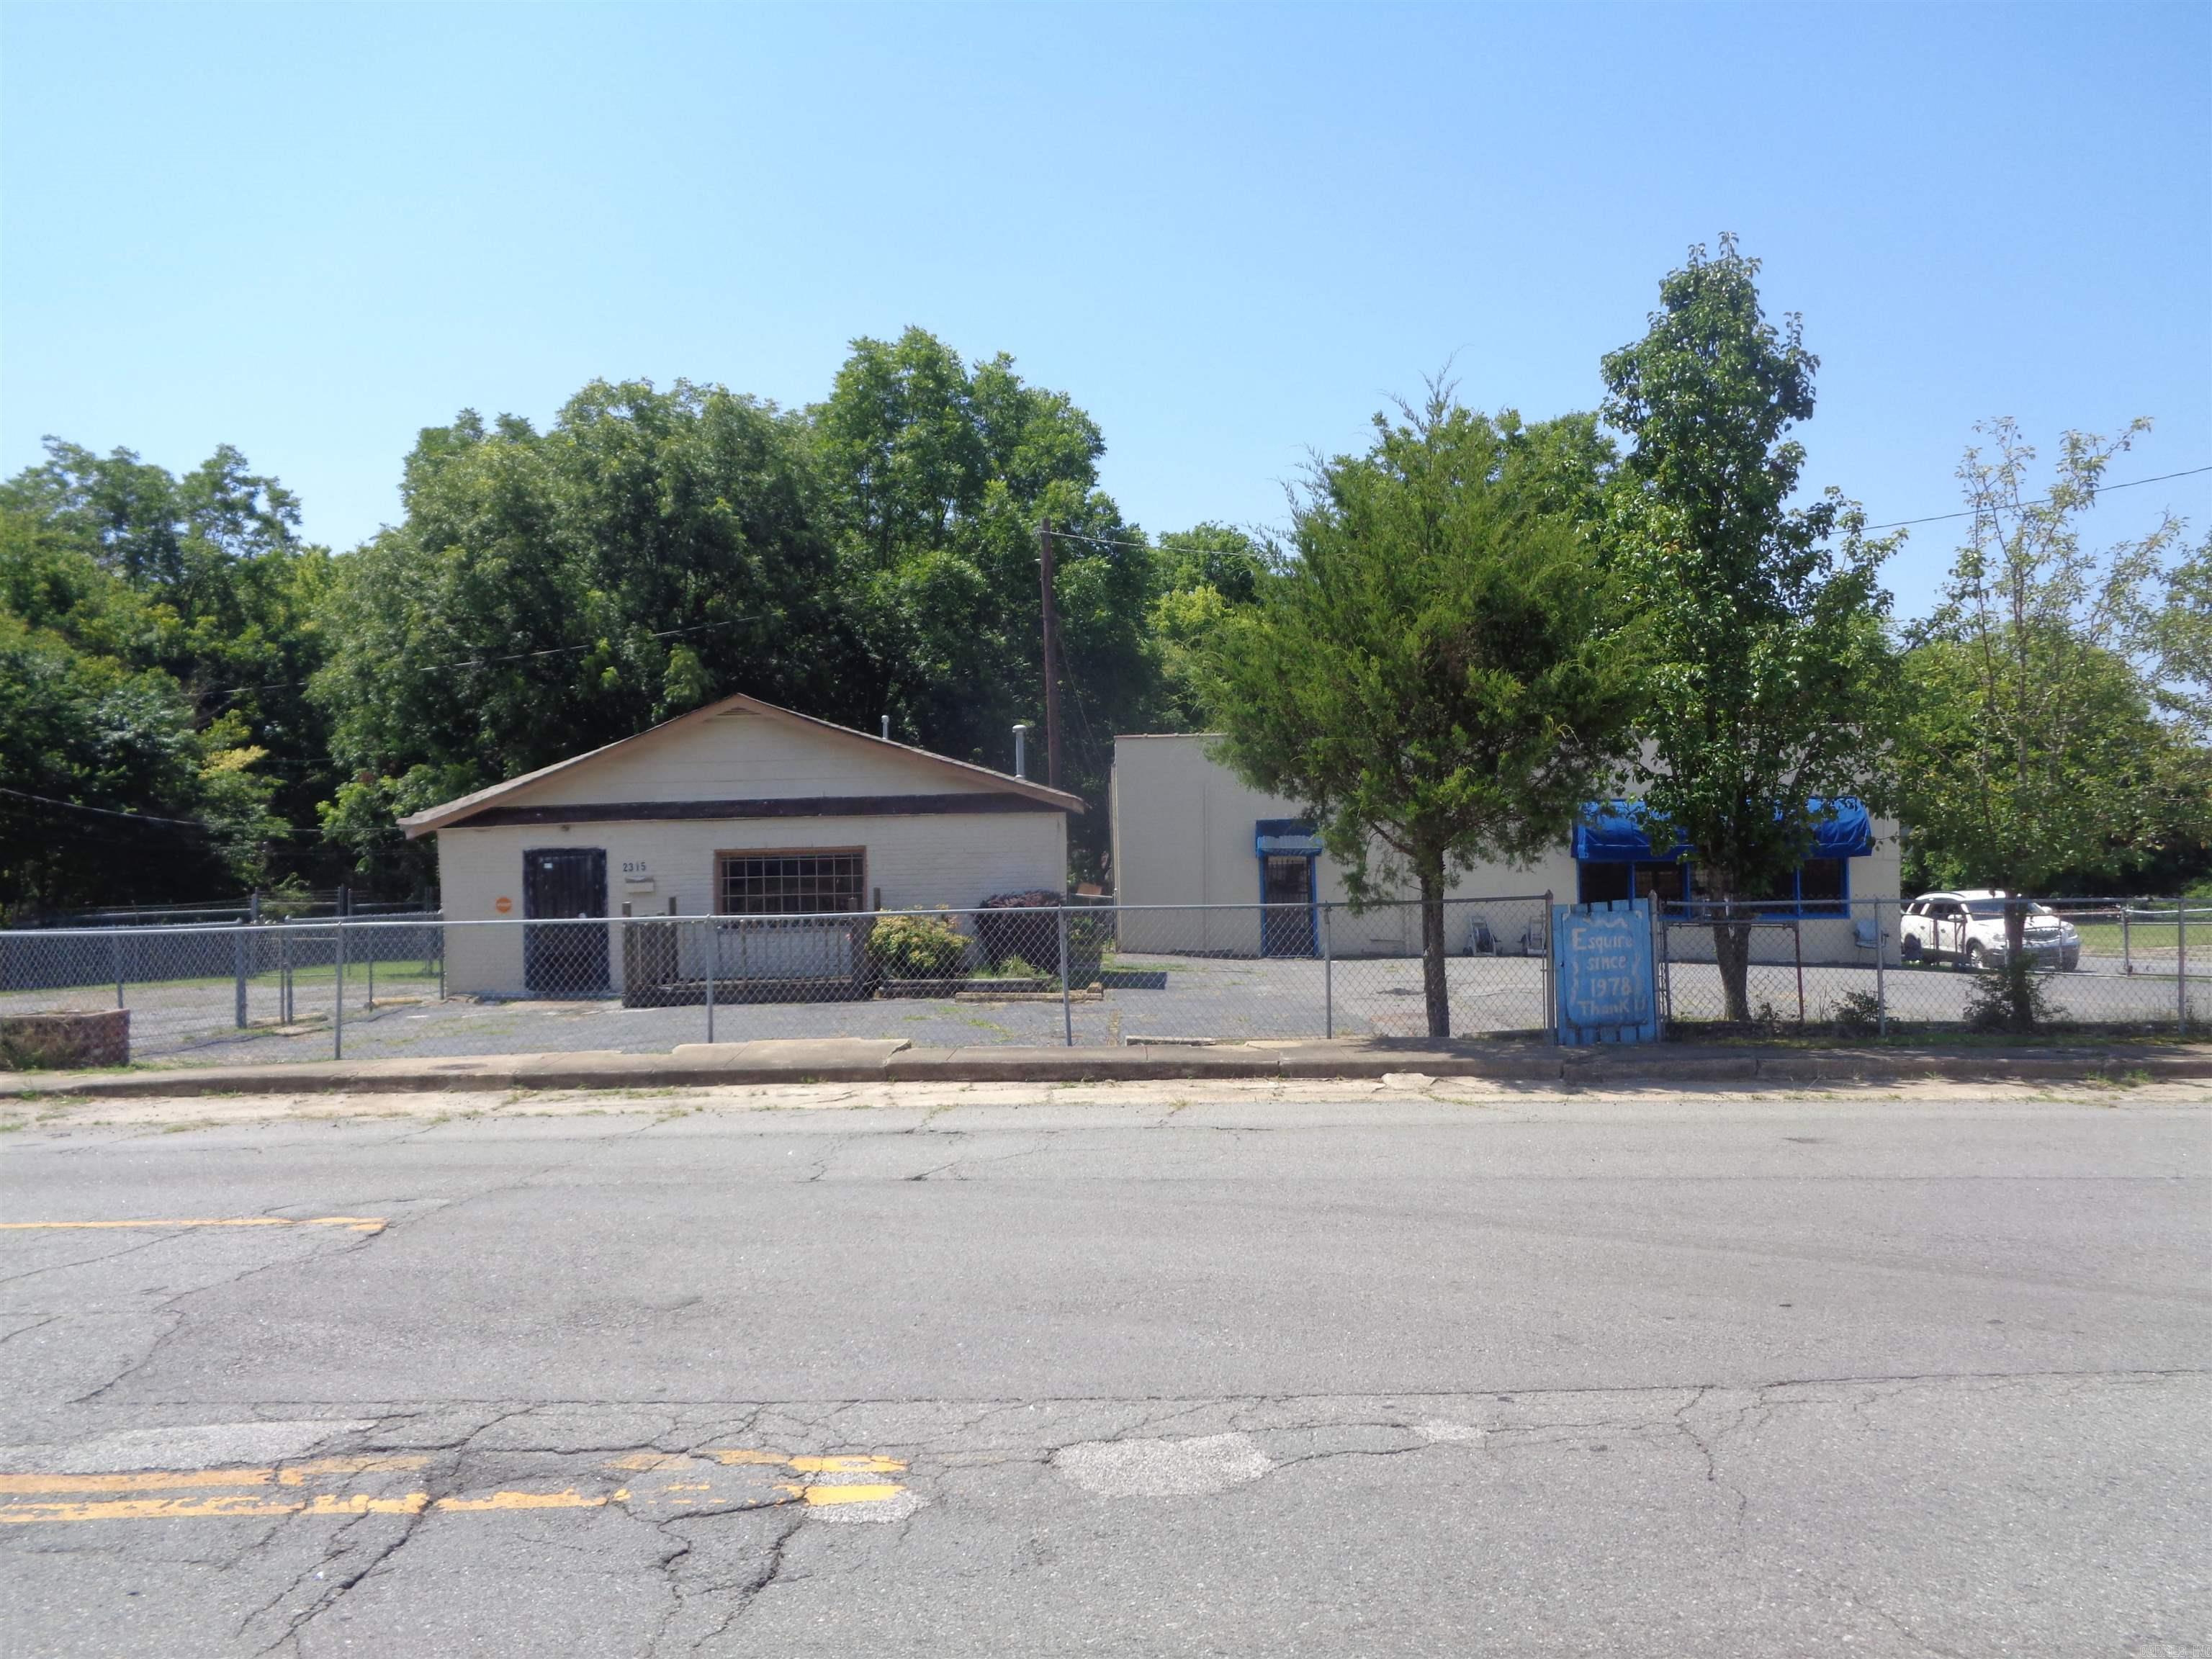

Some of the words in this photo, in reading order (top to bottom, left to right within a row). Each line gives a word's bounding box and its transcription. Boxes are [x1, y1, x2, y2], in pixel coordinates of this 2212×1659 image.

[623, 862, 646, 872] 2315
[1572, 927, 1633, 953] Esquire
[1591, 976, 1632, 997] 1978
